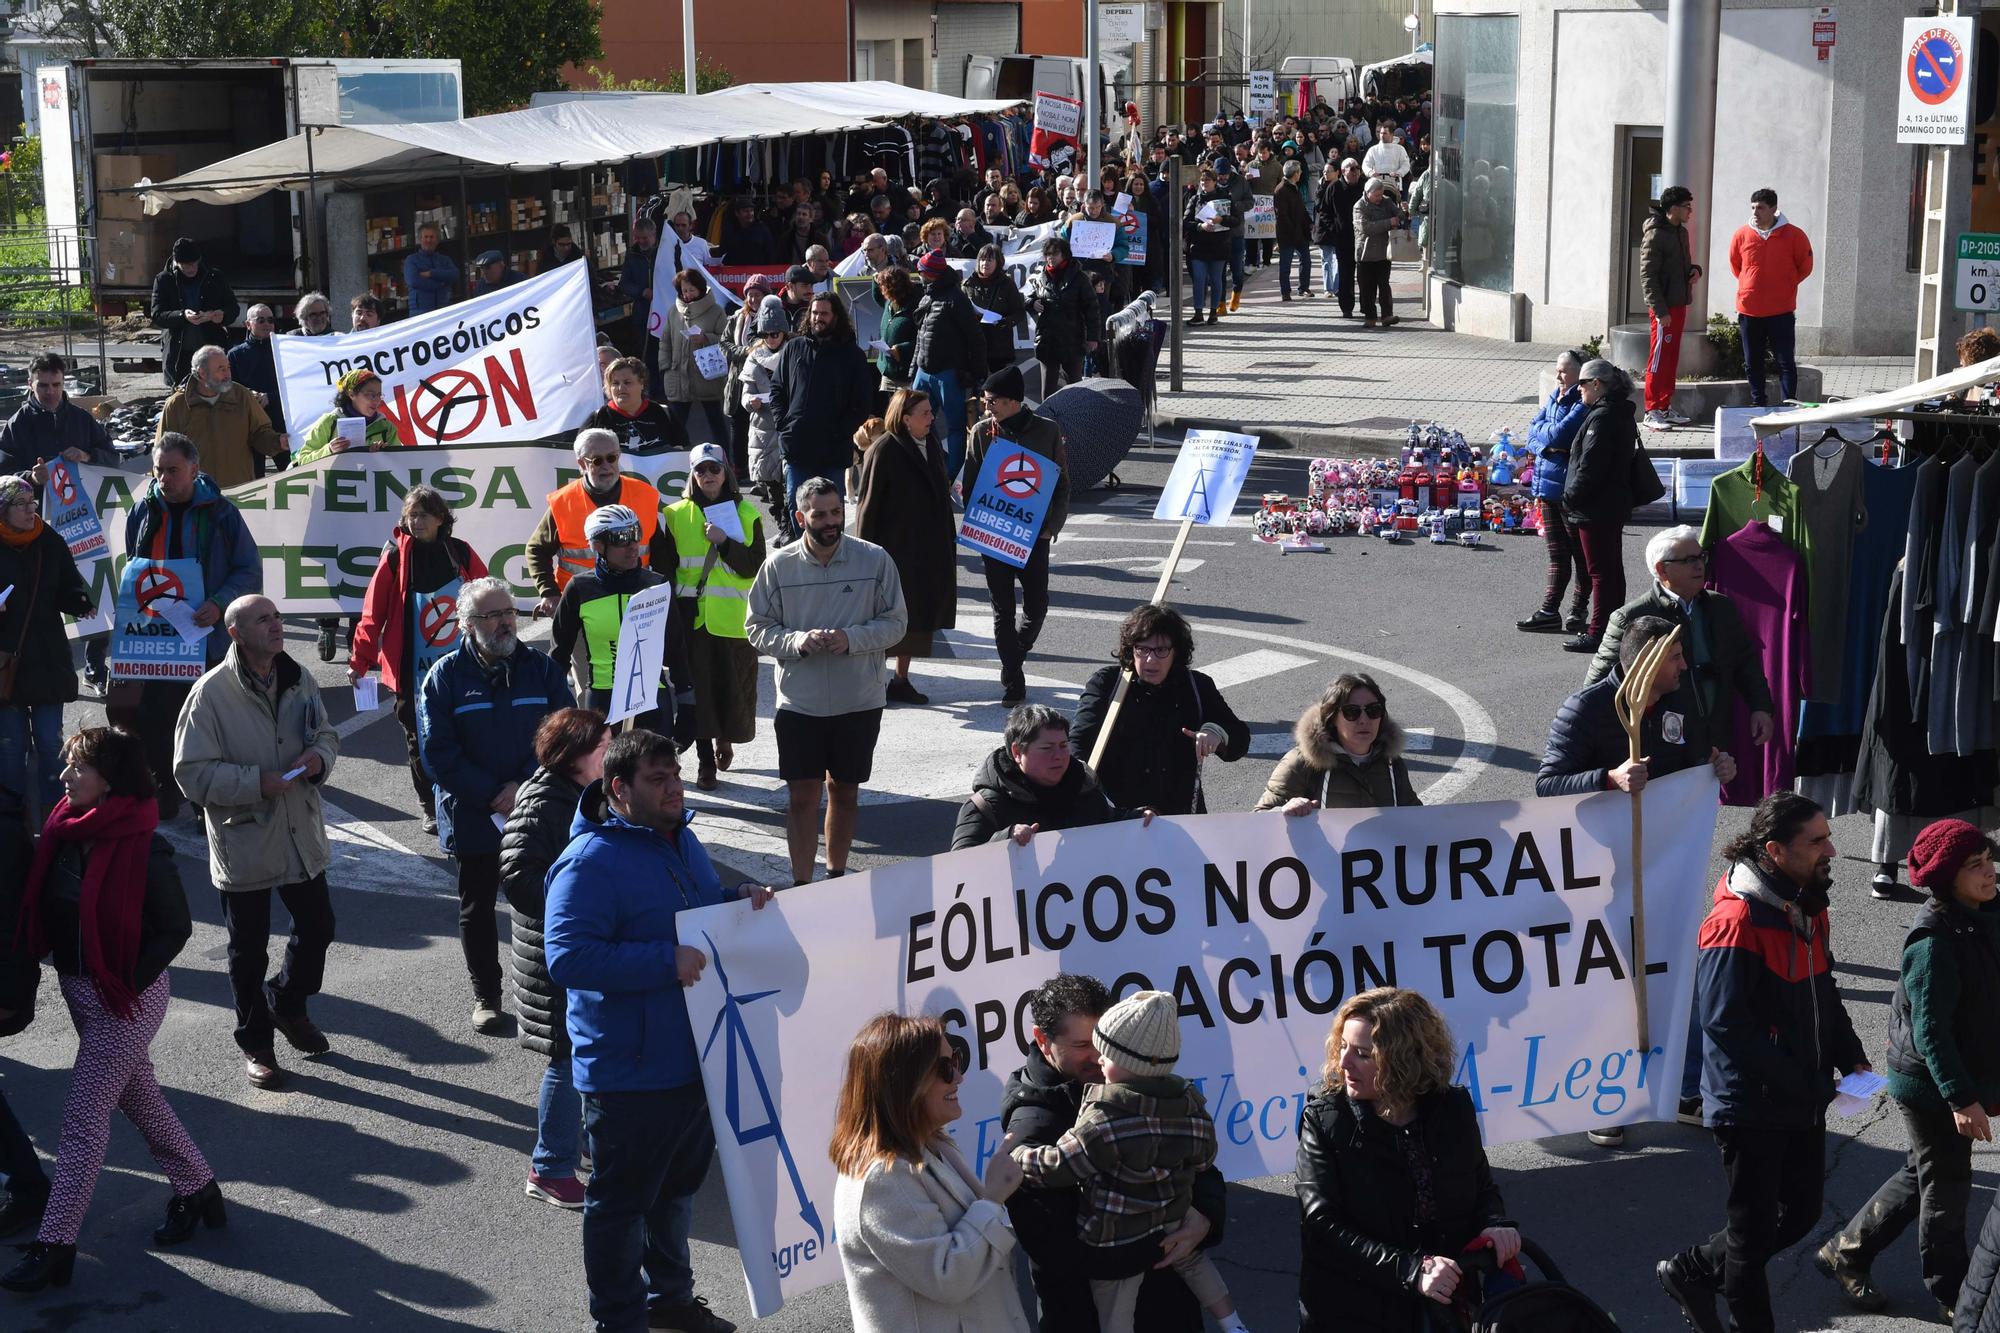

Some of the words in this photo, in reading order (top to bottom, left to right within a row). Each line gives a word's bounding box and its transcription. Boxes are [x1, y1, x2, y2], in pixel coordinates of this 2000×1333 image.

[1910, 33, 1929, 57] DIAS
[1930, 29, 1942, 38] DE
[1943, 31, 1962, 57] FEIRA
[1899, 126, 1935, 134] DOMINGO
[1936, 126, 1947, 134] DO
[1949, 126, 1965, 135] MES
[1906, 115, 1912, 124] 4,
[1915, 115, 1923, 123] 13
[1930, 113, 1958, 123] ÚLTIMO
[1971, 266, 1988, 278] km
[320, 306, 541, 386] macroeólicos
[1223, 439, 1243, 448] LIÑAS
[226, 466, 532, 513] EFENSA
[55, 504, 89, 528] ALDEAS
[977, 493, 1034, 525] ALDEAS
[84, 518, 99, 532] DE
[968, 507, 1013, 533] LIBRES
[1012, 525, 1033, 542] DE
[961, 524, 1028, 560] MACROEÓLICOS
[119, 640, 176, 655] LIBRES
[179, 642, 200, 656] DE
[114, 662, 202, 677] MACROEÓLICOS
[907, 868, 1176, 984] EÓLICOS
[1204, 856, 1311, 927] NO
[1341, 827, 1600, 915] RURAL
[1423, 915, 1667, 999] TOTAL
[1455, 1035, 1664, 1116] A-Legr
